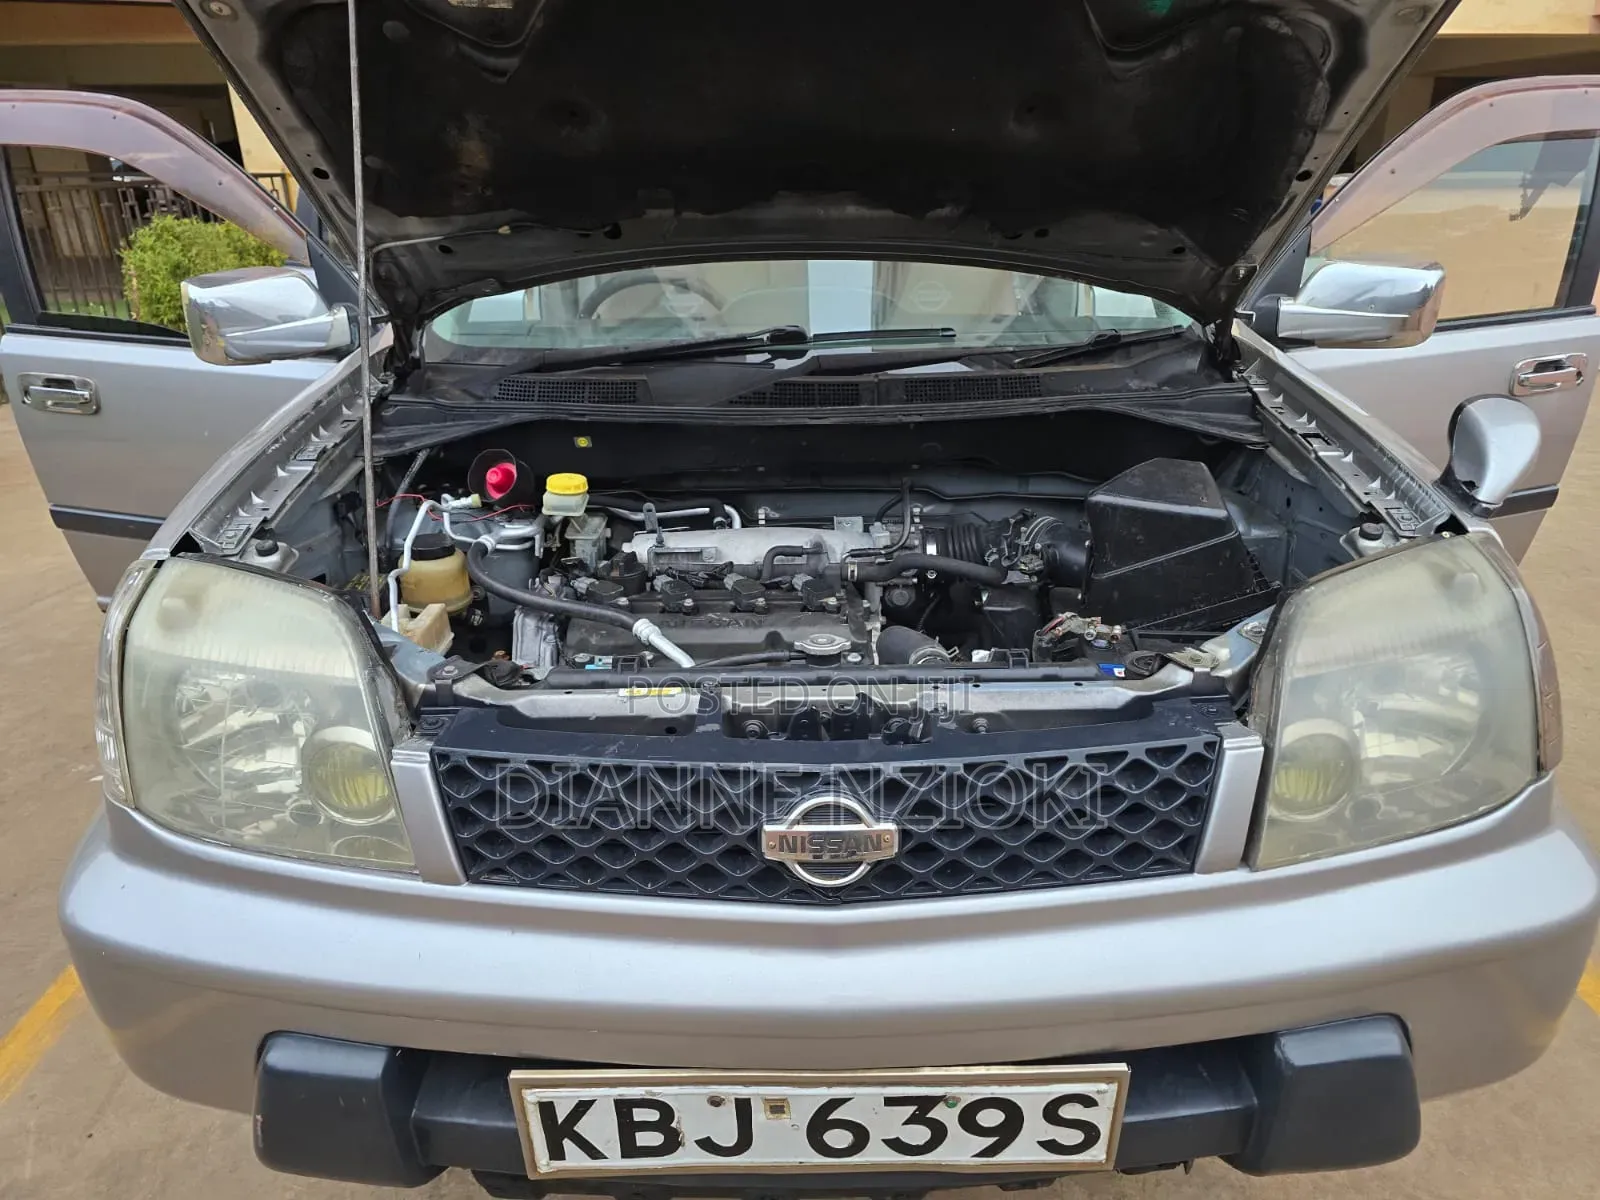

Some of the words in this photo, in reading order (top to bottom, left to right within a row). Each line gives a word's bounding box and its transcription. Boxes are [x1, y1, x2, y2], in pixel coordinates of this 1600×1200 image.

[778, 832, 882, 854] NISSAN
[535, 1096, 755, 1162] KBJ
[804, 1092, 1103, 1159] 639S
